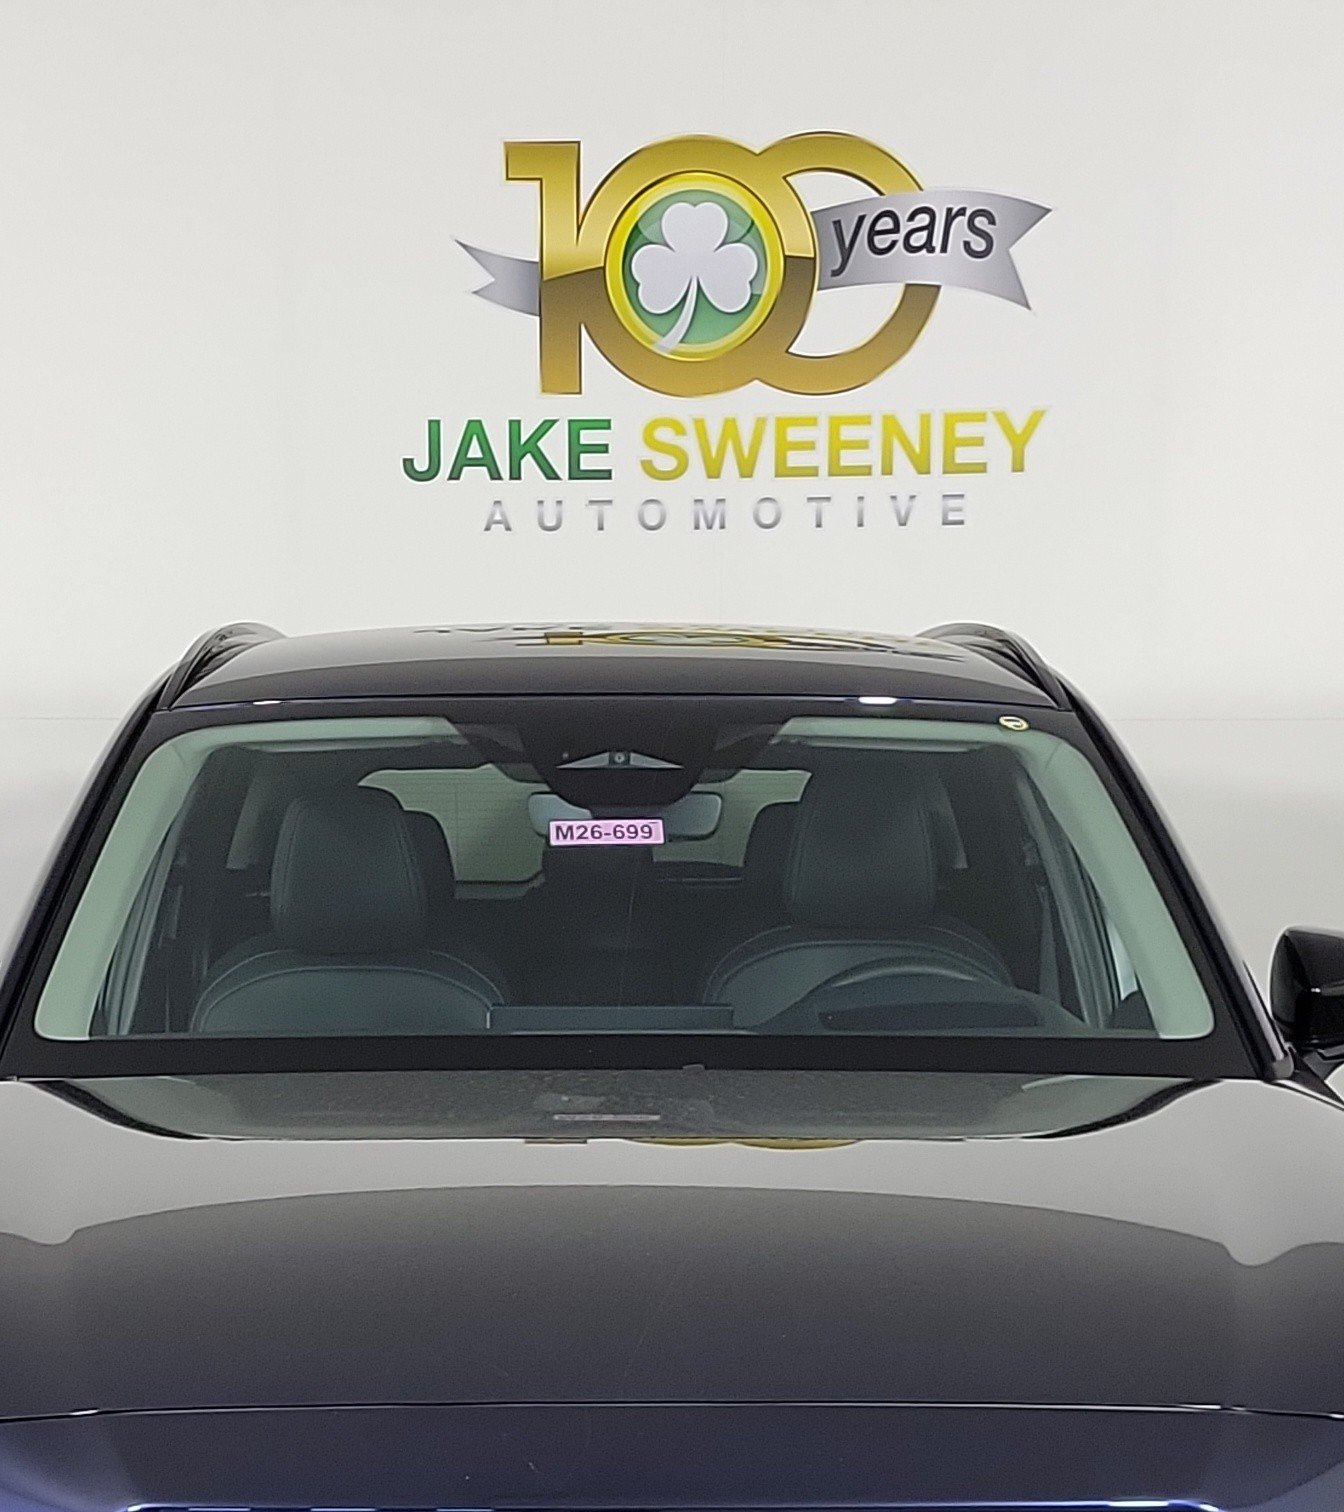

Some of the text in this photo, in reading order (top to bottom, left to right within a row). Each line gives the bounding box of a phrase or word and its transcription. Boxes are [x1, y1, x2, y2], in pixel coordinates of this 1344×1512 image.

[504, 131, 997, 396] 100 years
[402, 409, 1046, 482] JAKE SWEENEY
[483, 493, 966, 532] AUTOMOTIVE
[555, 824, 653, 841] M26-699
